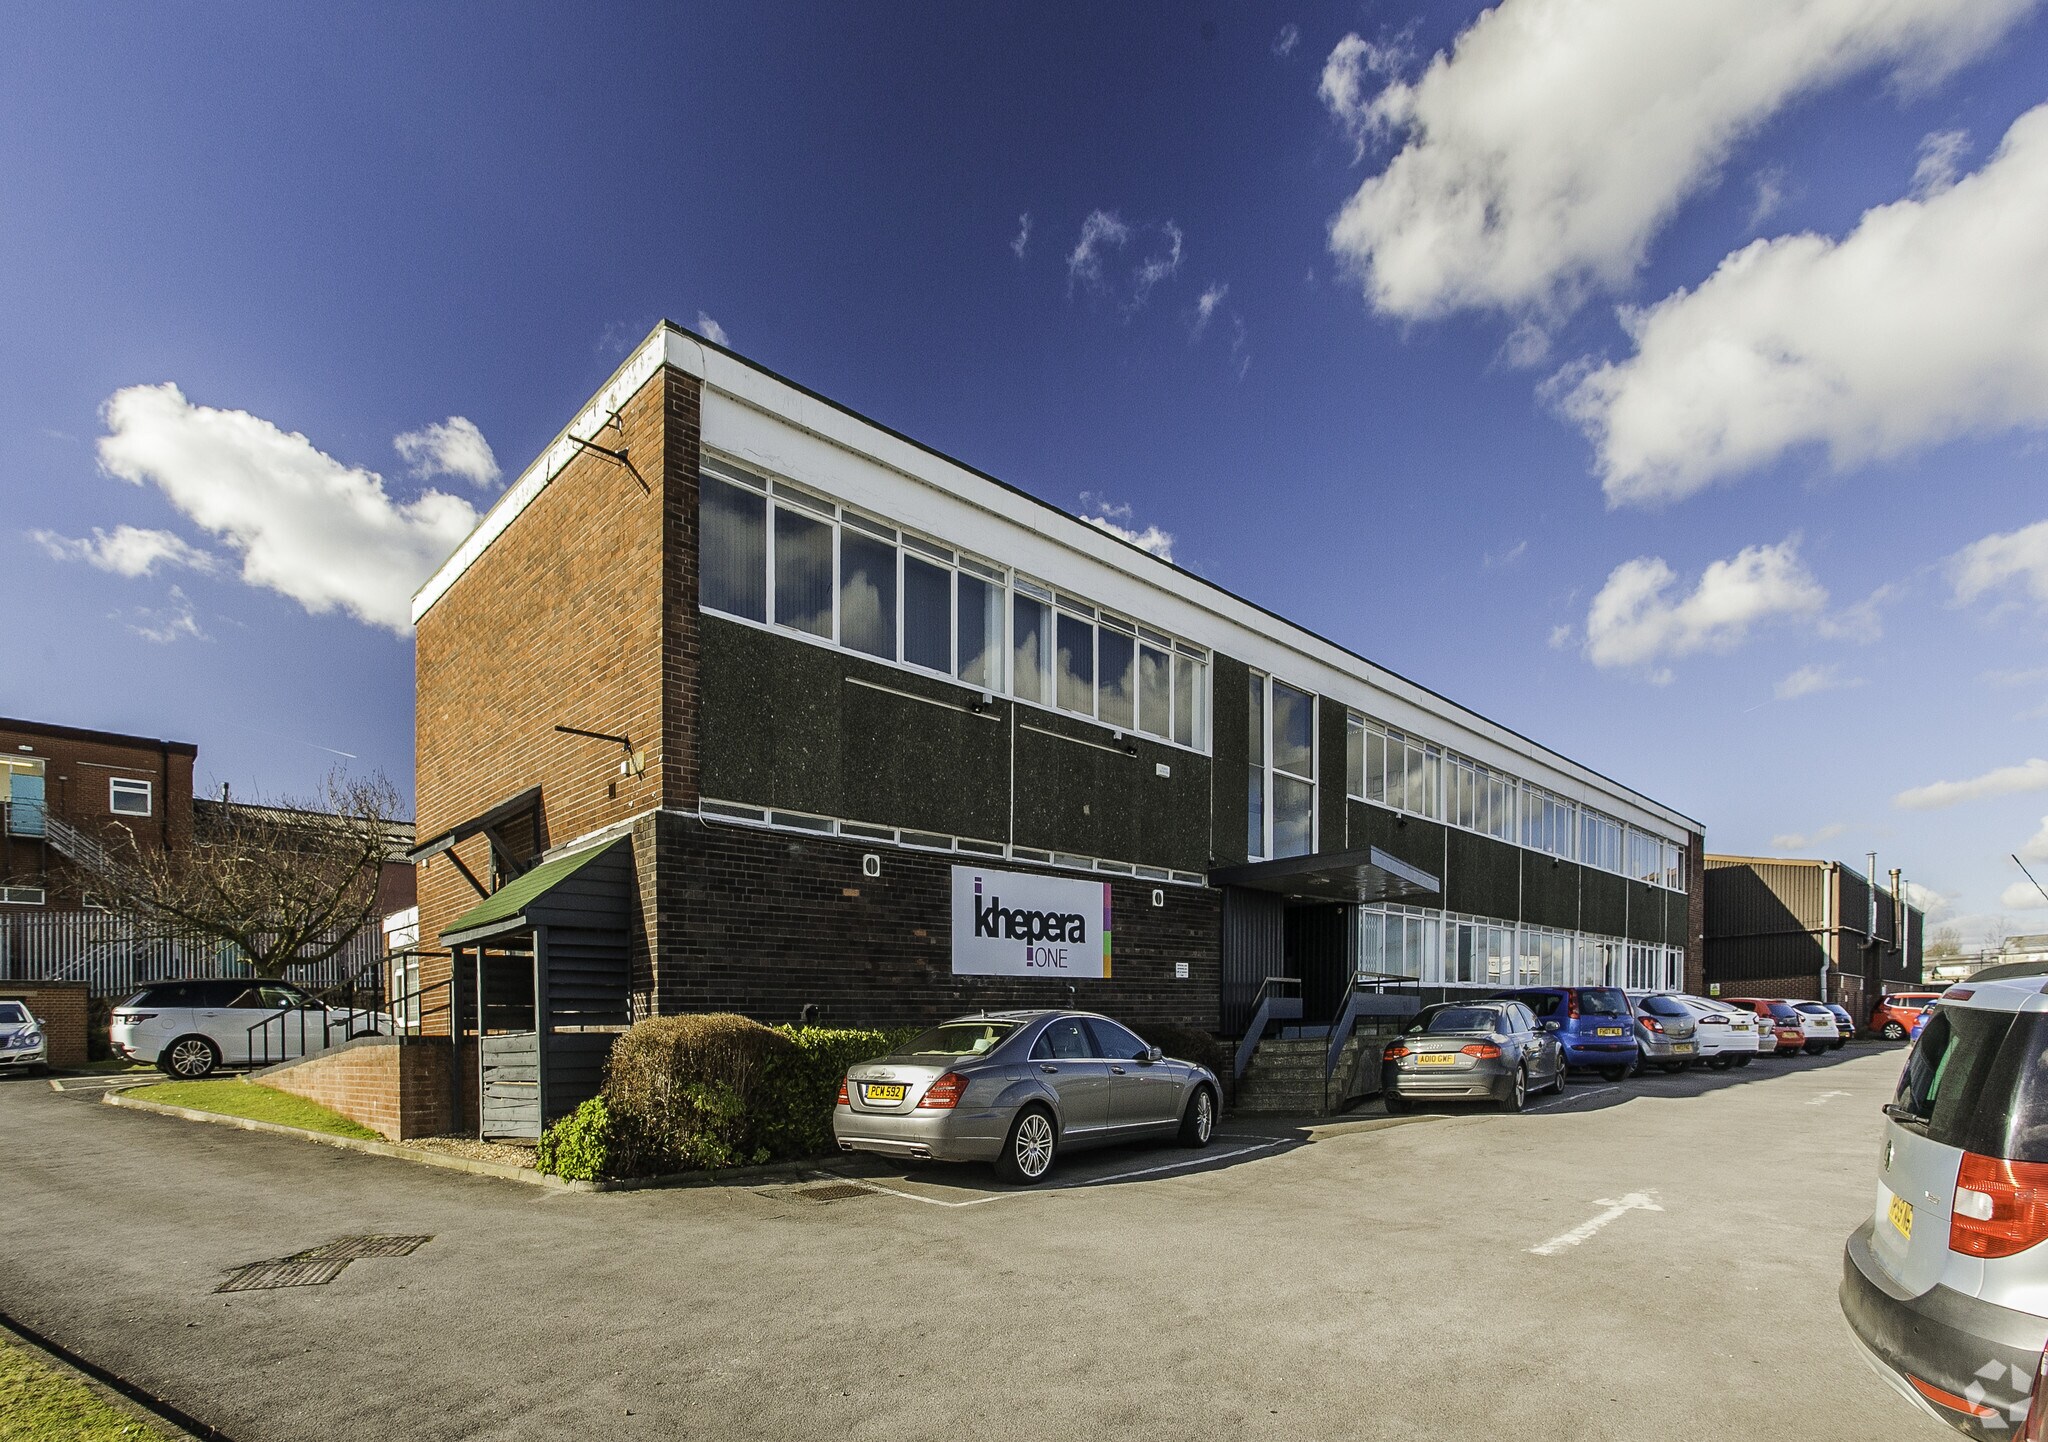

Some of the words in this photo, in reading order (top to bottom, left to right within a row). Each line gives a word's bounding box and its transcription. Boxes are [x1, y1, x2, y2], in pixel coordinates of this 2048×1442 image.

[974, 894, 1086, 946] khepera
[1035, 947, 1068, 968] ONE
[886, 1086, 901, 1098] 592
